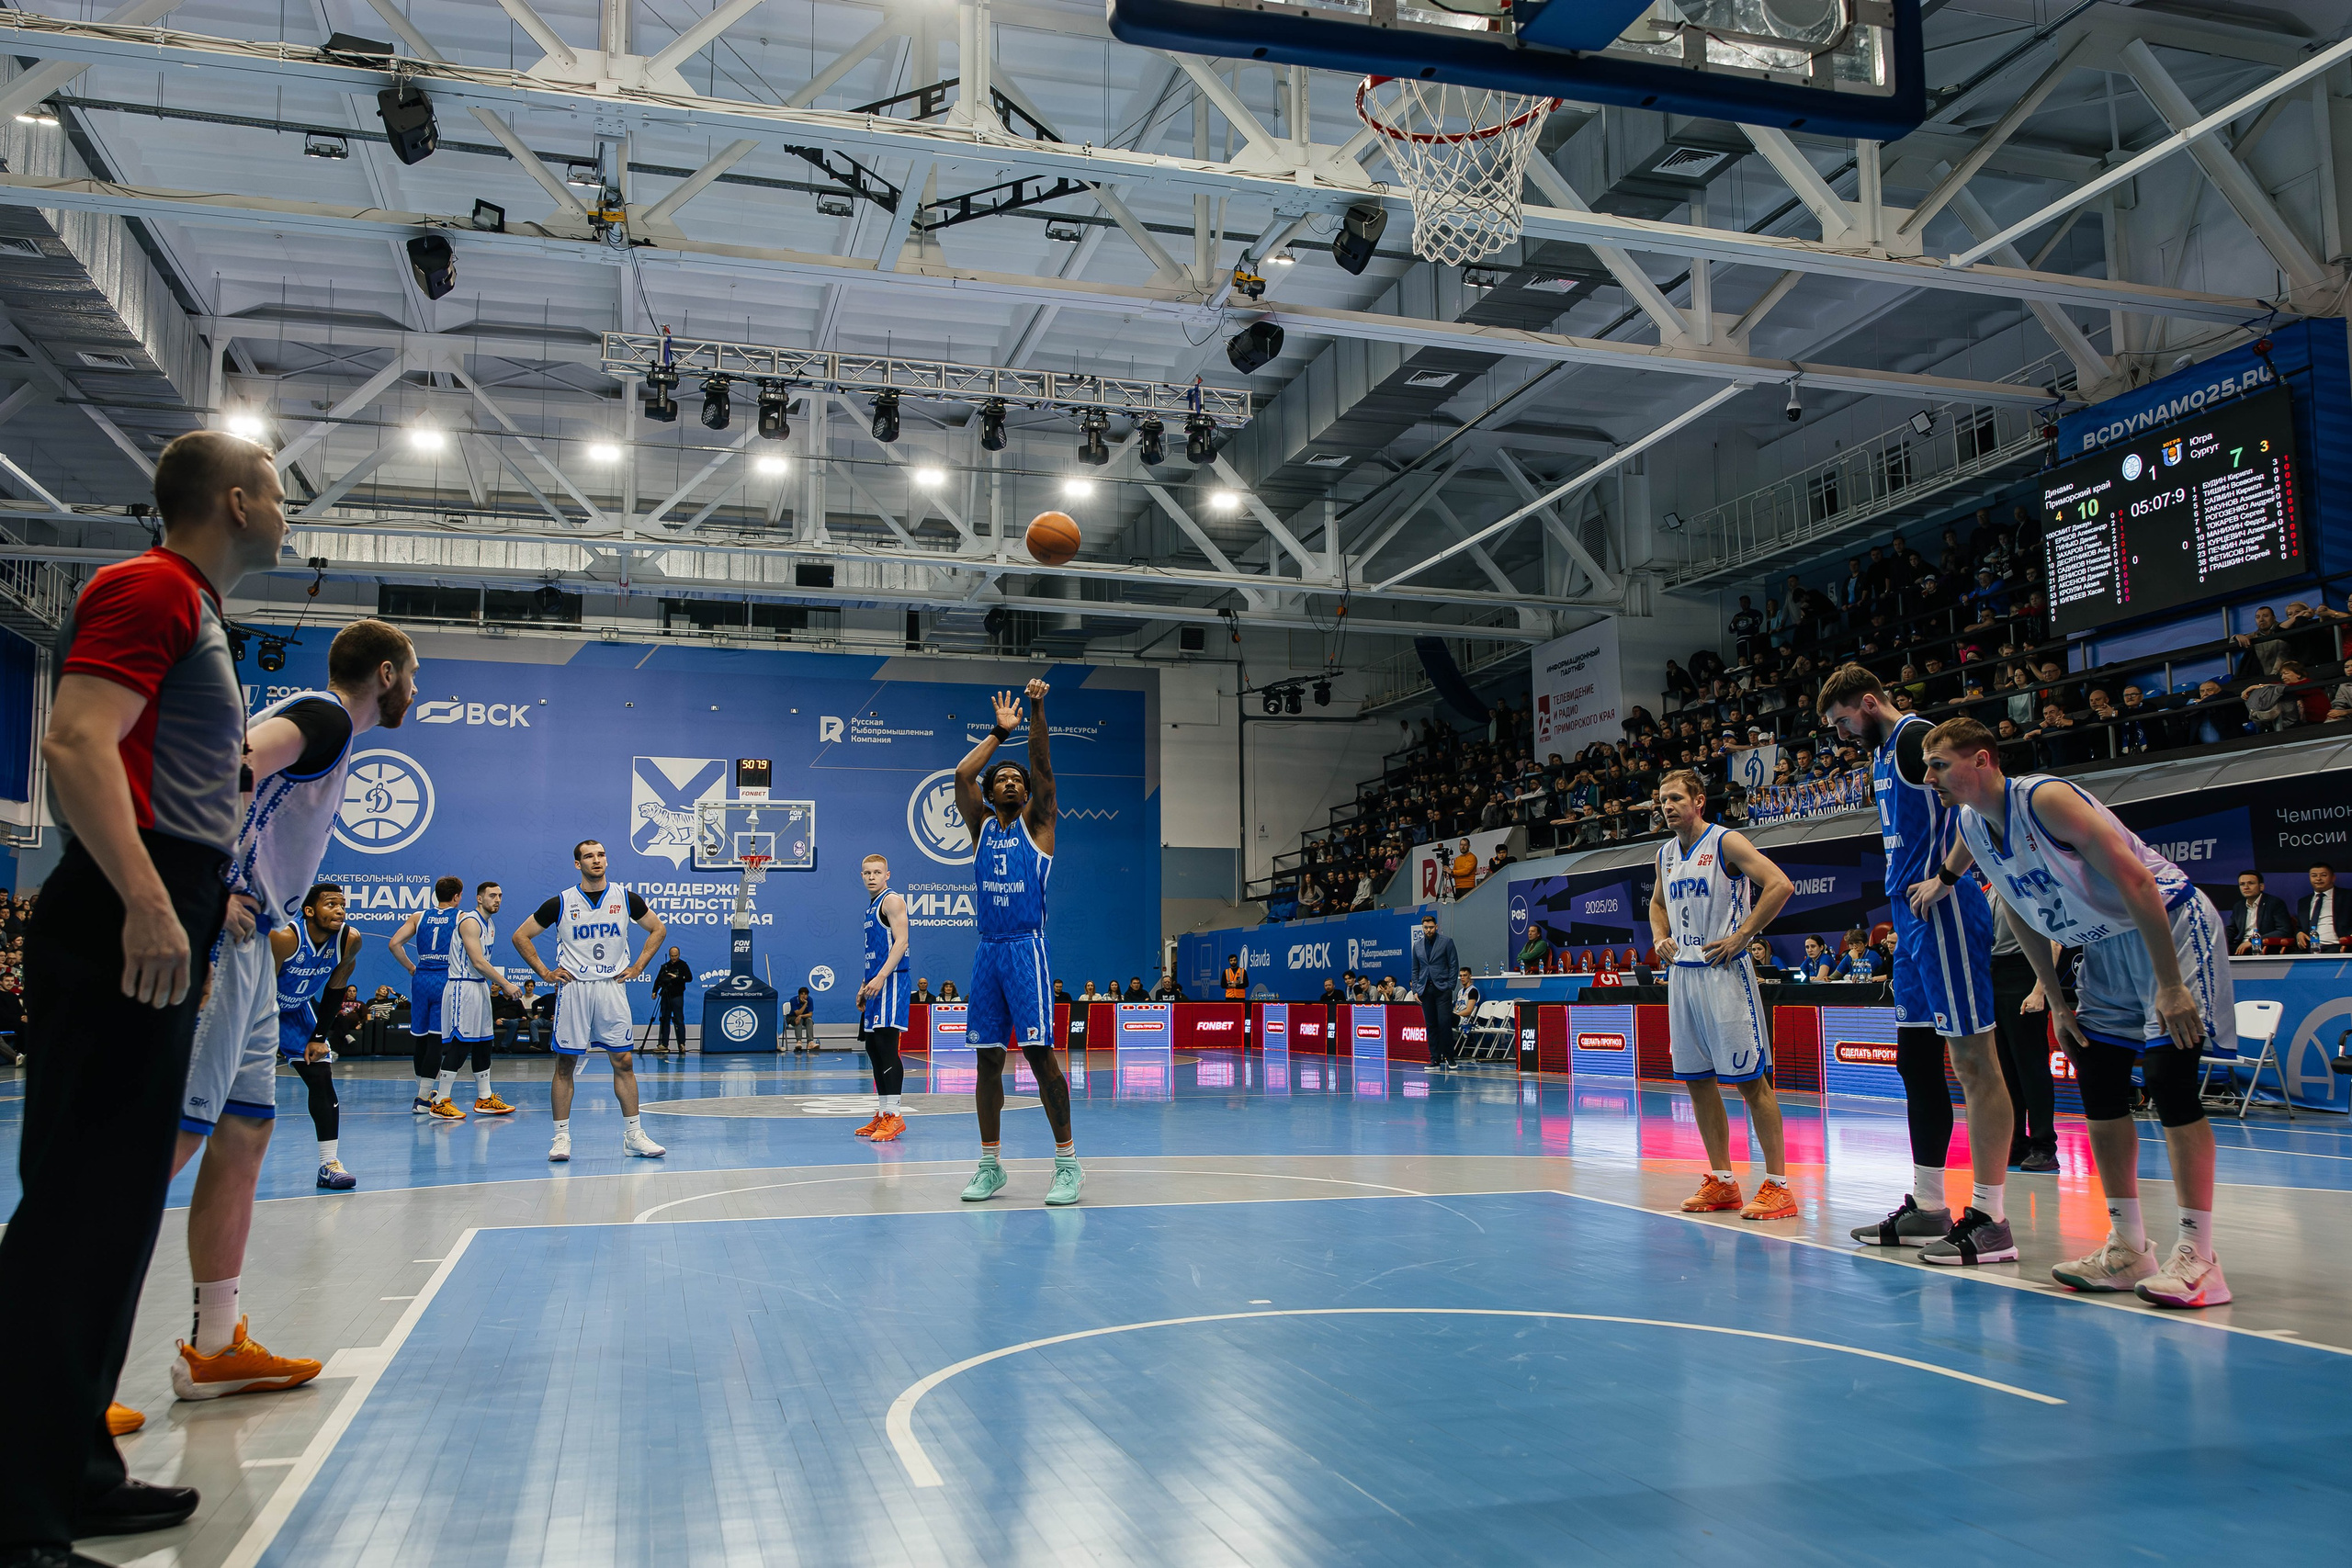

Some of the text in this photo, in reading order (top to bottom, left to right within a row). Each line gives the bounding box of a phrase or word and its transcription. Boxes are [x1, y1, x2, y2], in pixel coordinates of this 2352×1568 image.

[2189, 433, 2213, 446] Югра
[2260, 440, 2269, 452] 3
[2190, 443, 2220, 458] Сургут
[2230, 446, 2243, 468] 7
[2148, 465, 2156, 480] 1
[2202, 476, 2227, 490] БУДИН
[2045, 483, 2075, 500] Динамо
[2045, 479, 2111, 510] Приморский край
[2077, 498, 2099, 520] 10
[2131, 488, 2186, 517] 05:07:9
[2055, 511, 2063, 522] 4
[2197, 534, 2205, 542] 10
[2196, 542, 2205, 550] 22
[2197, 550, 2206, 558] 23
[1546, 647, 1600, 673] ИНФОРМАЦИОННЫЙ
[1553, 683, 1594, 705] ТЕЛЕВИДЕНИЕ
[1554, 705, 1578, 720] И РАДИО
[851, 717, 884, 727] Русская
[1554, 708, 1615, 735] ПРИМОРСКОГО КРАЯ
[851, 726, 933, 737] Рыбопромышленная
[1049, 726, 1097, 734] КВА-РЕСУРСЫ
[2278, 830, 2346, 848] России
[318, 873, 430, 884] БАСКЕТБОЛЬНЫЙ КЛУБ
[908, 883, 978, 892] ВОЛЕЙБОЛЬНЫЙ
[1585, 898, 1618, 914] 2025/26
[724, 913, 774, 925] КАЯ
[1511, 909, 1526, 920] РФБ
[572, 922, 621, 941] ЮГРА
[2069, 924, 2110, 944] Utair
[432, 926, 439, 951] 1
[1361, 939, 1377, 947] Русская
[593, 942, 605, 960] 6
[1250, 948, 1271, 967] slavda
[1361, 948, 1402, 958] Рыбопромышленная
[295, 979, 310, 994] 0
[1196, 1021, 1234, 1031] FONBET
[1299, 1022, 1319, 1036] FONBET
[1327, 1031, 1335, 1039] BET
[1521, 1028, 1535, 1039] FON
[1521, 1039, 1535, 1051] BET
[1580, 1038, 1623, 1048] СДЕЛАТЬ ПРОГНОЗ
[1840, 1047, 1897, 1059] СДЕЛАТЬ ПРОГН
